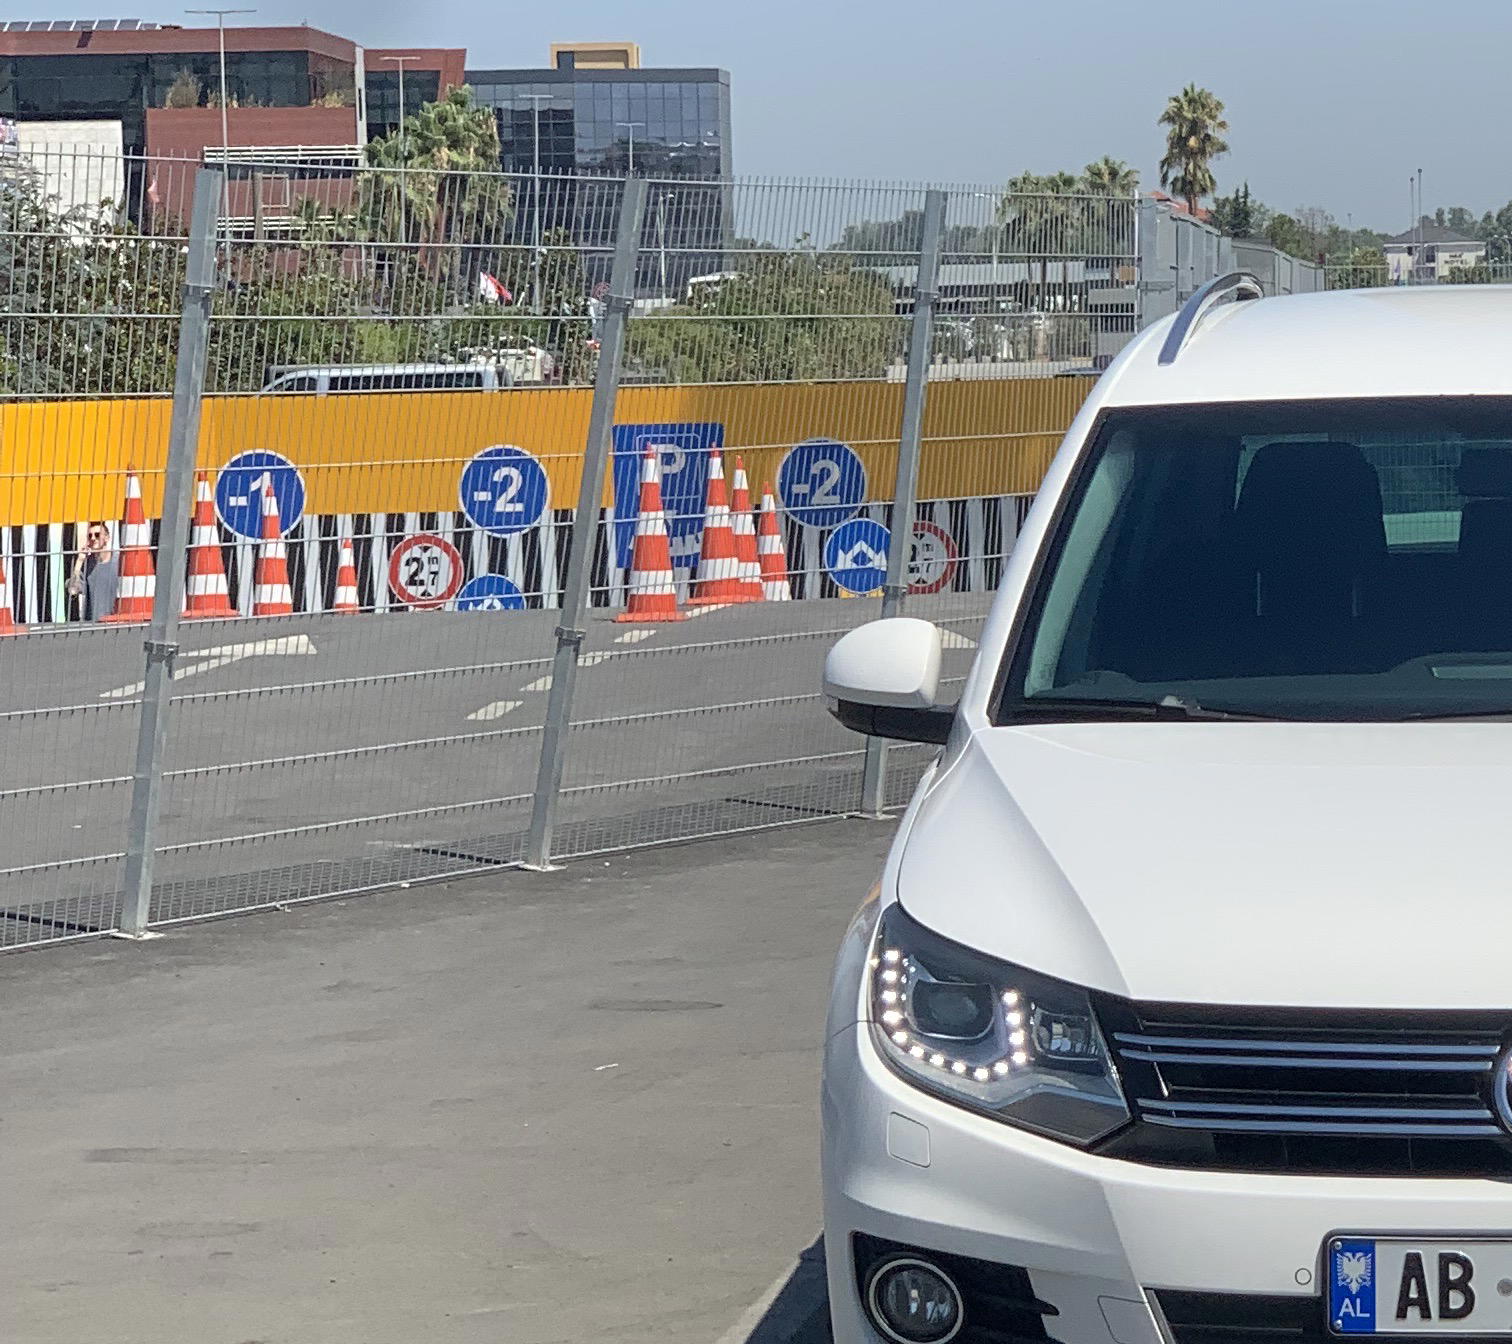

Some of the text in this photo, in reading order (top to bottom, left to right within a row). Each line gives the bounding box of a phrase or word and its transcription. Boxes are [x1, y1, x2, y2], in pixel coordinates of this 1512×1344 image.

[474, 466, 524, 513] -2
[650, 443, 686, 490] P
[791, 460, 841, 505] -2
[229, 471, 272, 515] -1
[1338, 1297, 1371, 1318] AL
[1396, 1251, 1476, 1320] AB
